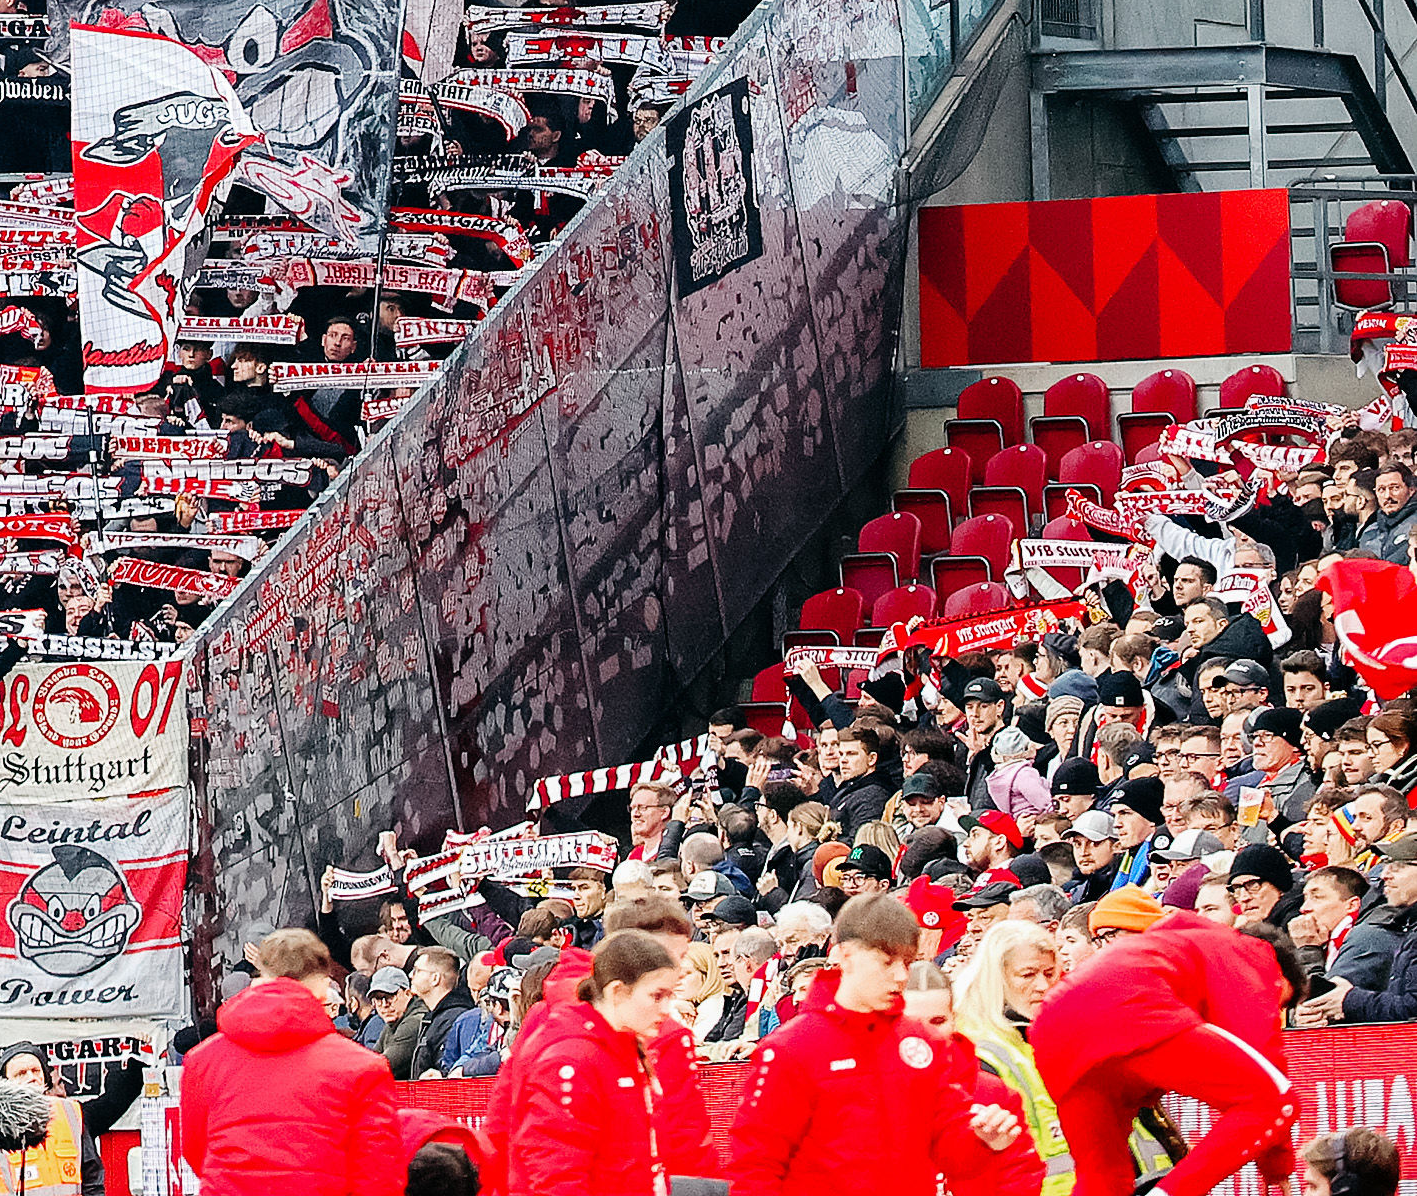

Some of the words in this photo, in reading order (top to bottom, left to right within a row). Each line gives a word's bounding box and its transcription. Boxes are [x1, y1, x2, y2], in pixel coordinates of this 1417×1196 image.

[272, 360, 422, 381] CANNSTATTER
[1024, 543, 1054, 558] VfB
[133, 660, 184, 740] 07
[1, 745, 154, 794] Stuttgart
